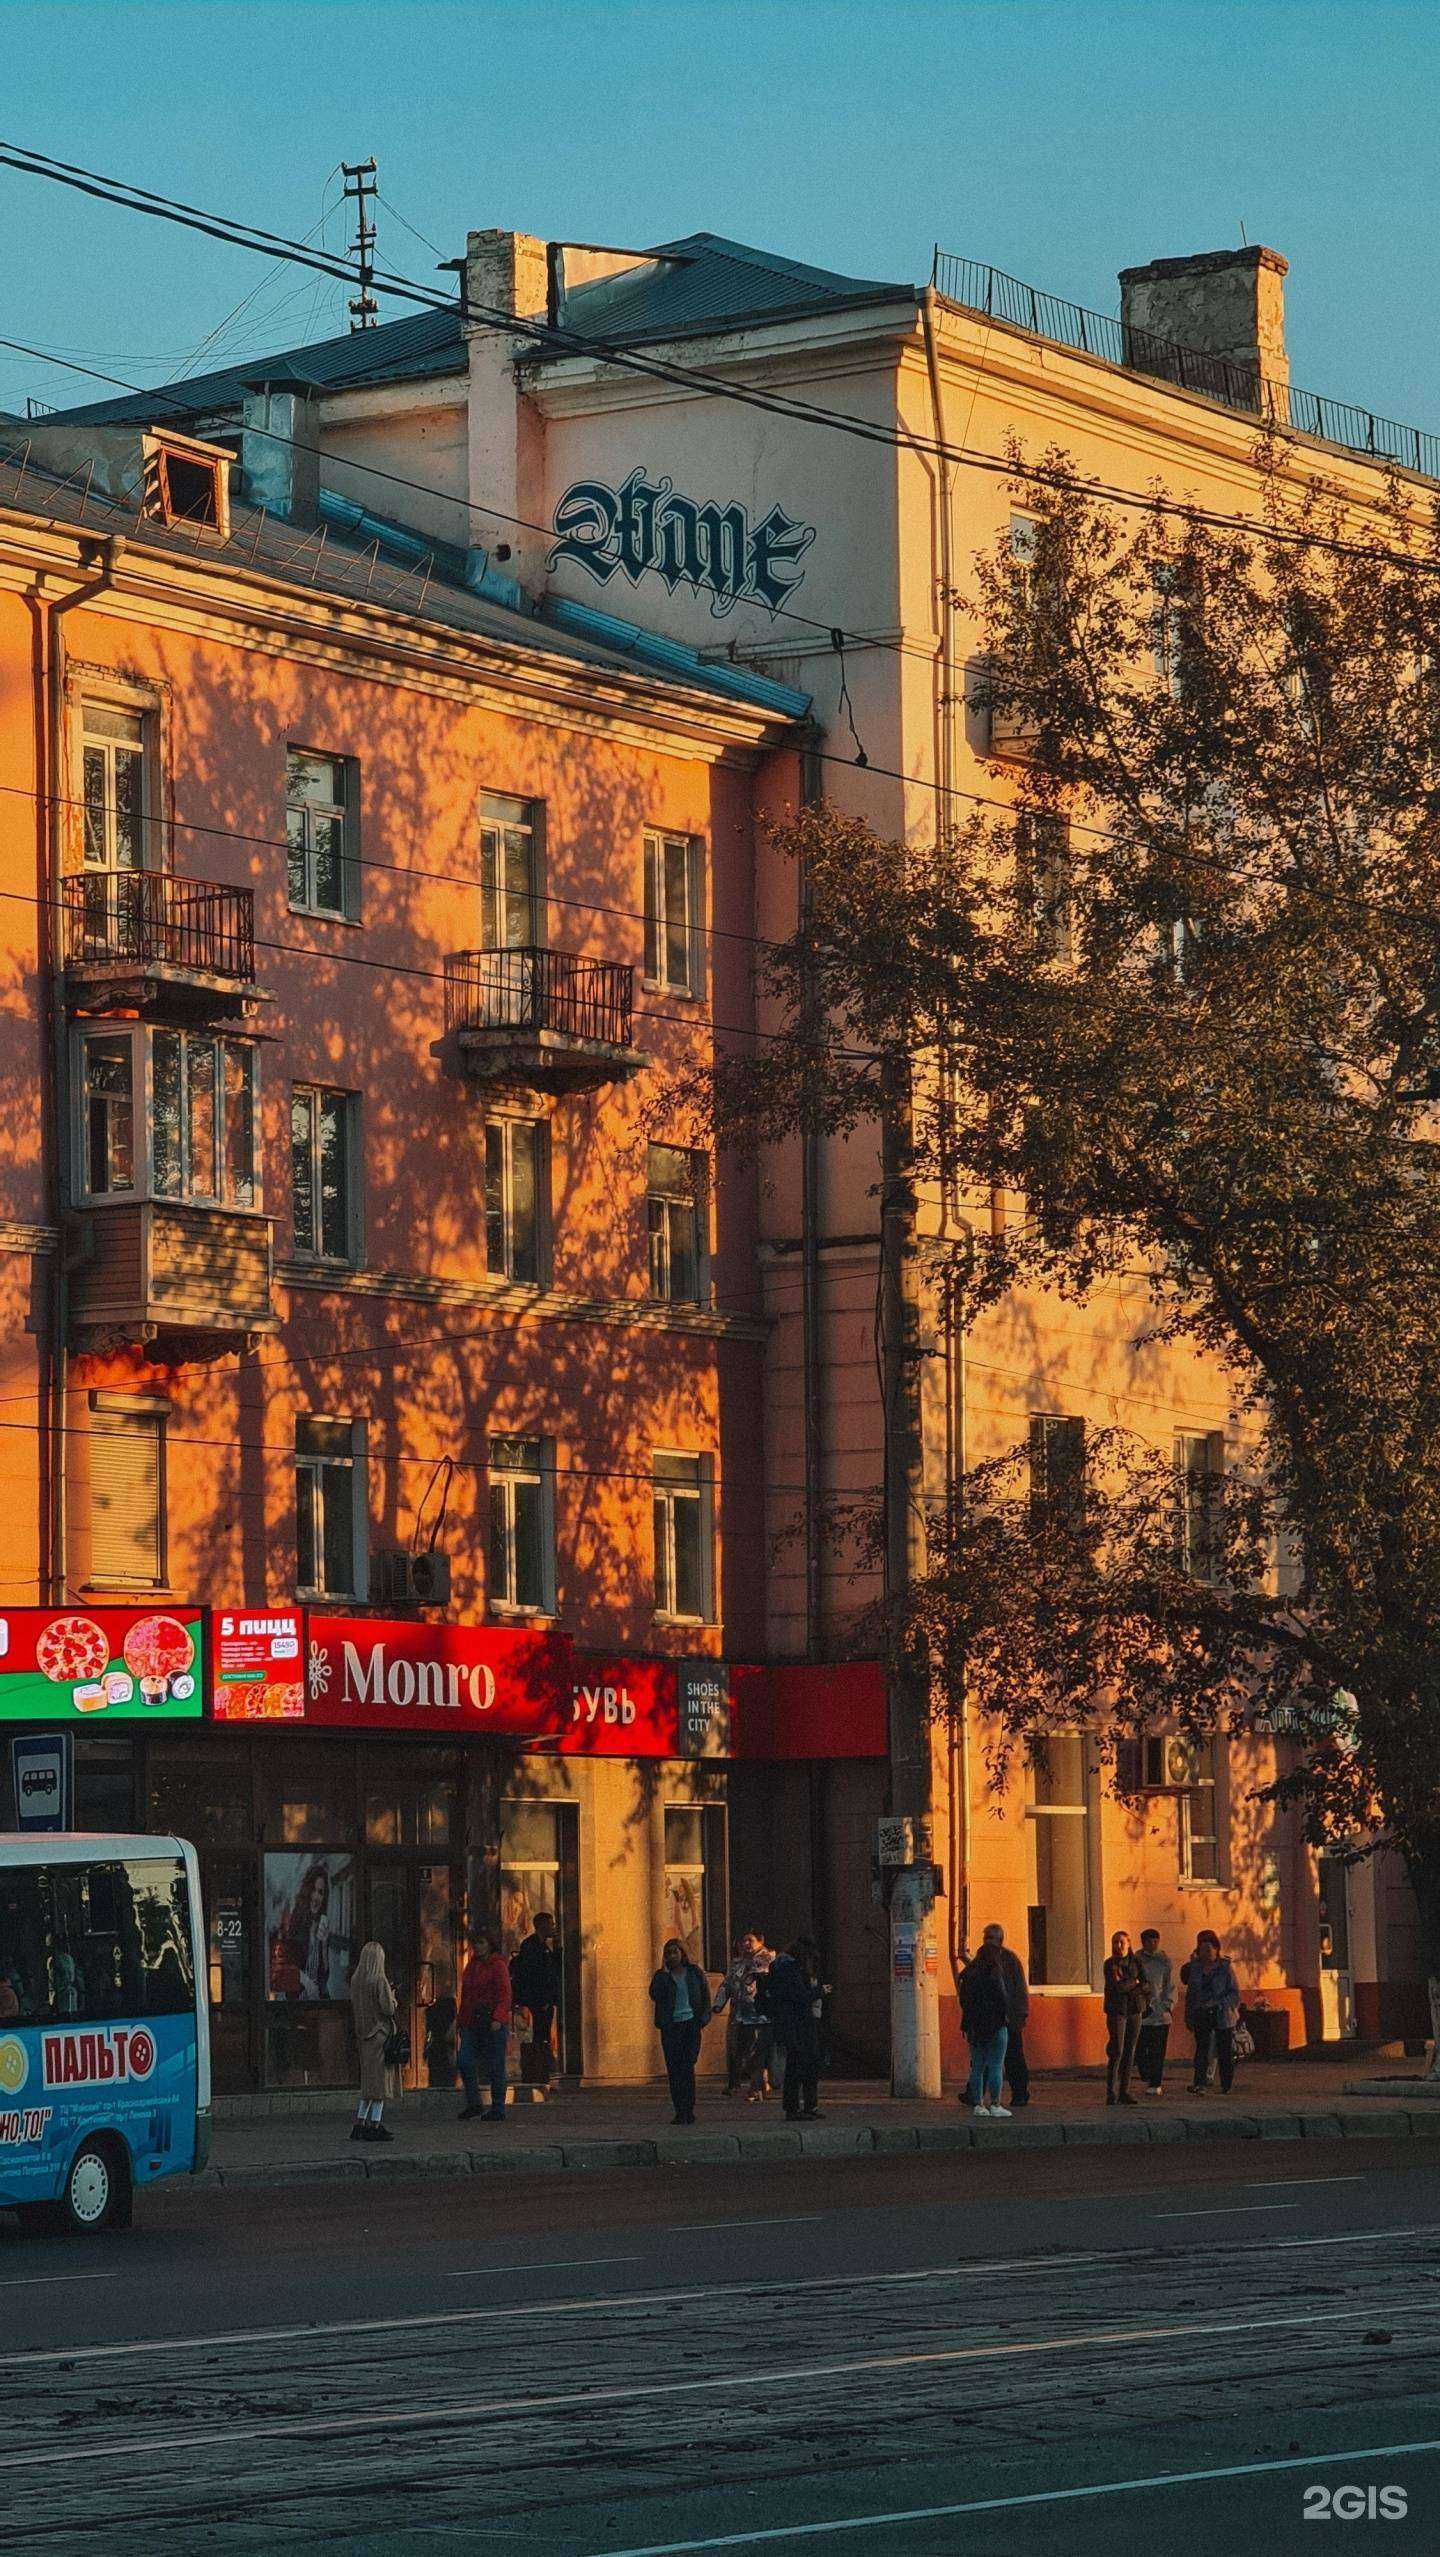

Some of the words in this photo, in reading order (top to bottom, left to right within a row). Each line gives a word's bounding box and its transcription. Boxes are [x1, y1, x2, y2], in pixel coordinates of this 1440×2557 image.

[221, 1617, 234, 1636] 5
[341, 1640, 496, 1709] Monro
[688, 1682, 719, 1697] SHOES
[688, 1701, 699, 1714] IN
[700, 1702, 720, 1714] THE
[688, 1719, 710, 1732] CITY
[44, 2031, 153, 2084] ПАЛЬТО
